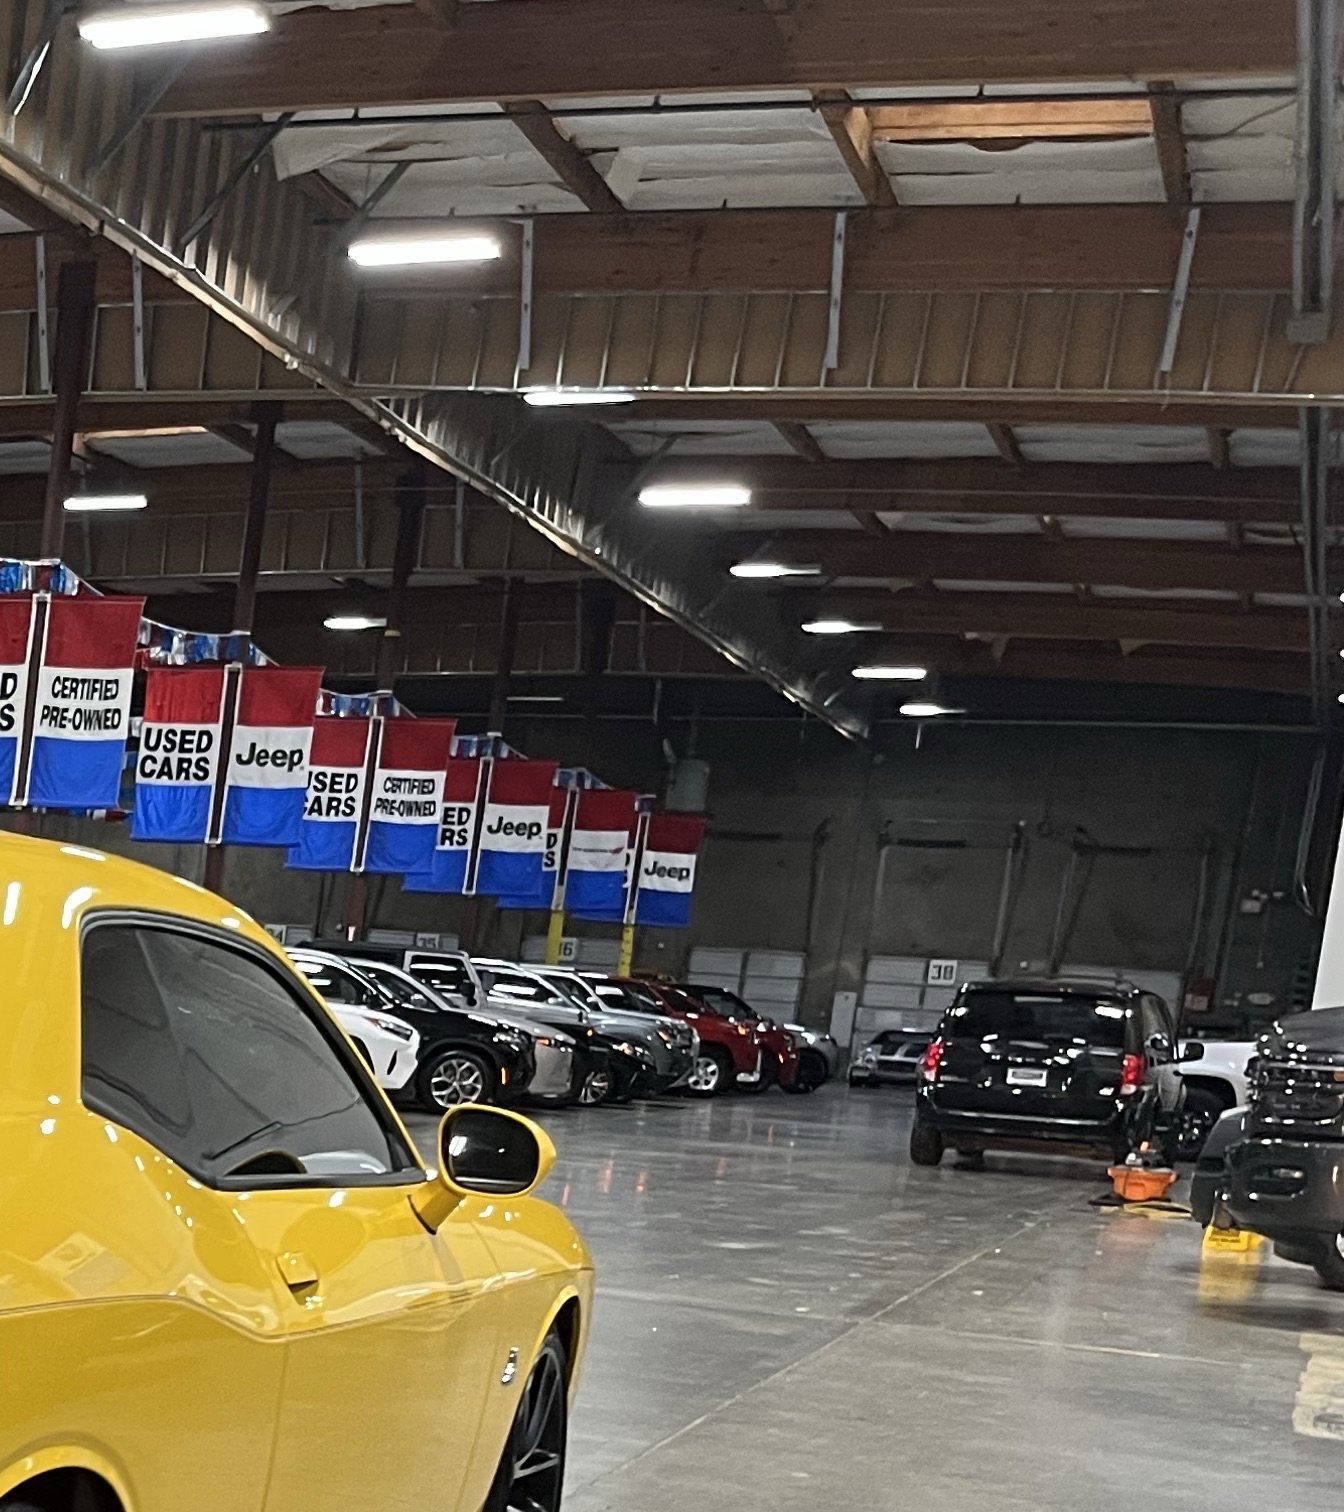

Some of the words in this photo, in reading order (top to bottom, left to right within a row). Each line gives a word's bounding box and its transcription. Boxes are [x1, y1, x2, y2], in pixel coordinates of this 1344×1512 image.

[51, 675, 119, 701] CERTIFIED
[39, 704, 122, 731] PRE-OWNED
[143, 727, 214, 754] USED
[139, 754, 210, 781] CARS
[235, 742, 304, 773] Jeep
[383, 776, 436, 795] CERTIFIED
[304, 795, 356, 817] ARS
[373, 797, 437, 817] PRE-OWNED
[486, 815, 543, 840] Jeep
[643, 861, 690, 881] Jeep
